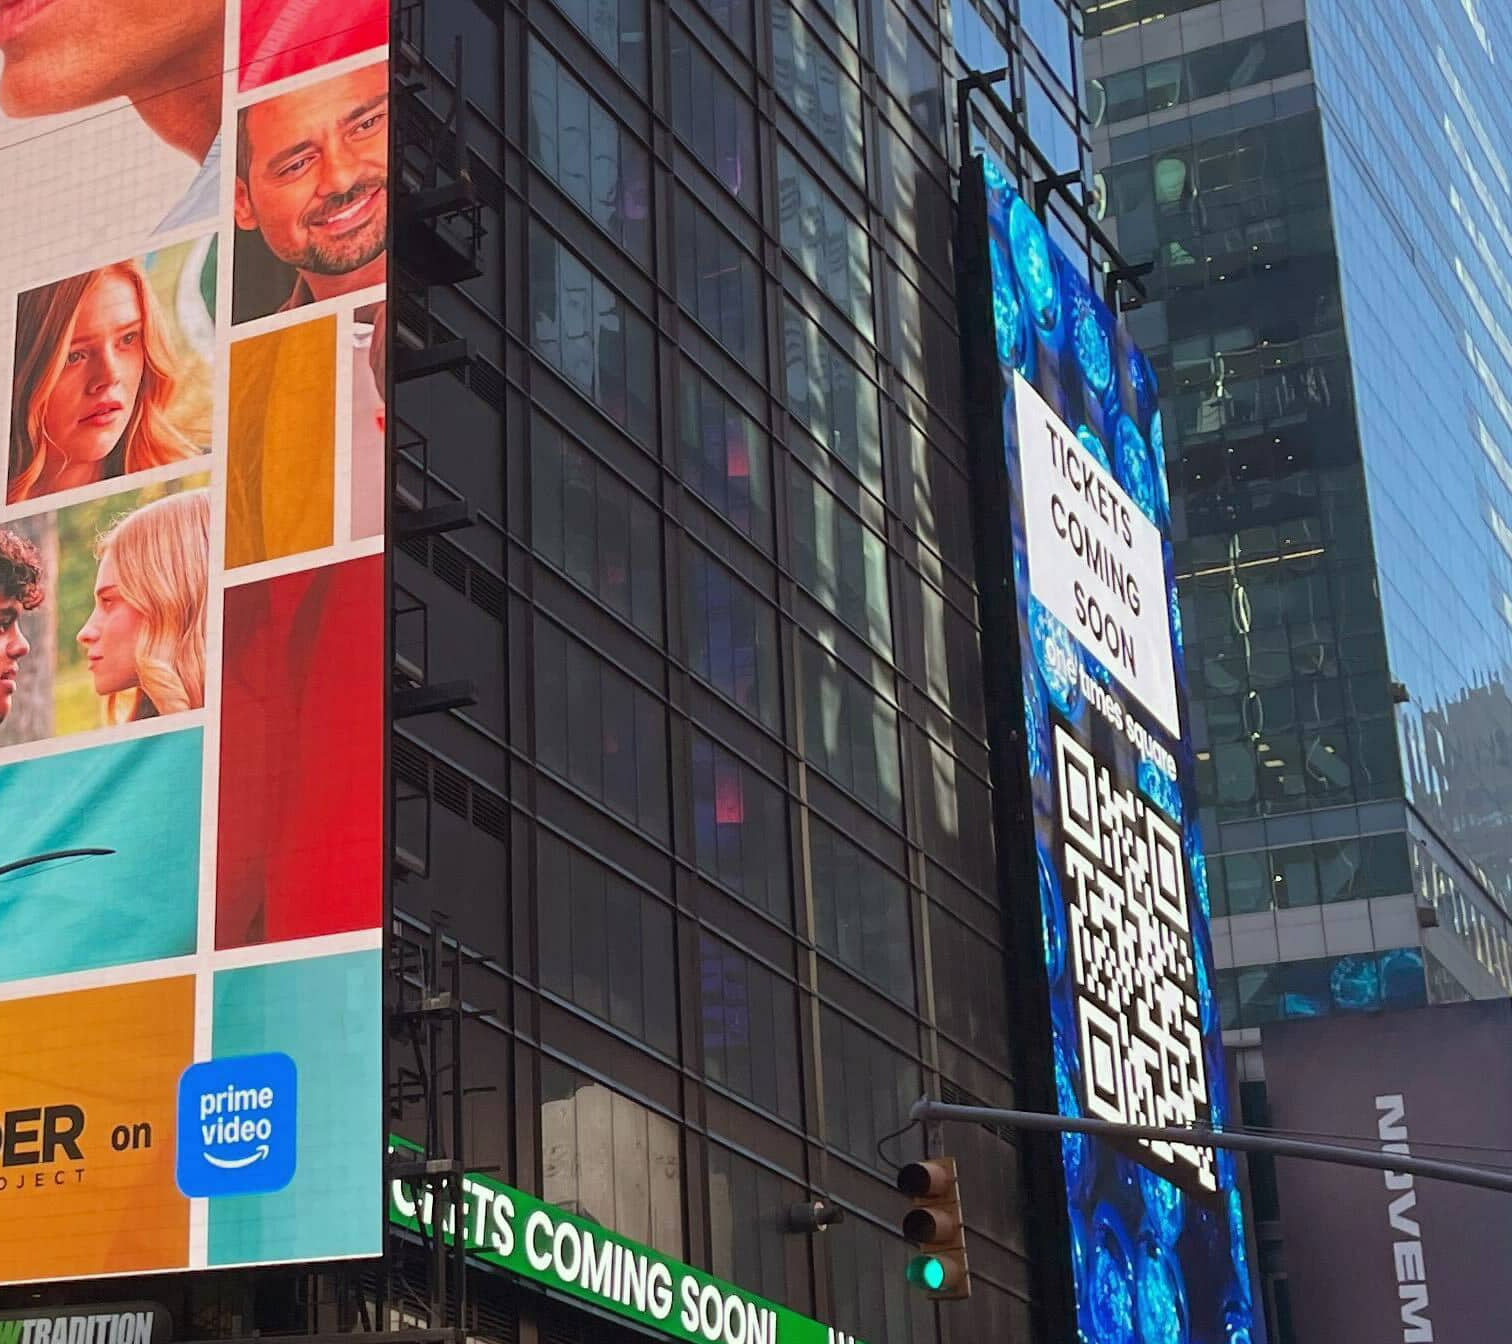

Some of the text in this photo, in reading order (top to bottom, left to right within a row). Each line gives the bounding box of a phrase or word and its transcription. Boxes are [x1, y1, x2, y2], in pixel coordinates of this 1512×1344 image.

[1046, 420, 1133, 549] TICKETS
[1050, 494, 1140, 617] COMING
[1074, 580, 1136, 678] SOON
[1044, 636, 1178, 783] one times square
[111, 1122, 152, 1151] on
[200, 1085, 274, 1122] prime
[201, 1116, 273, 1147] video
[525, 1210, 673, 1320] COMING
